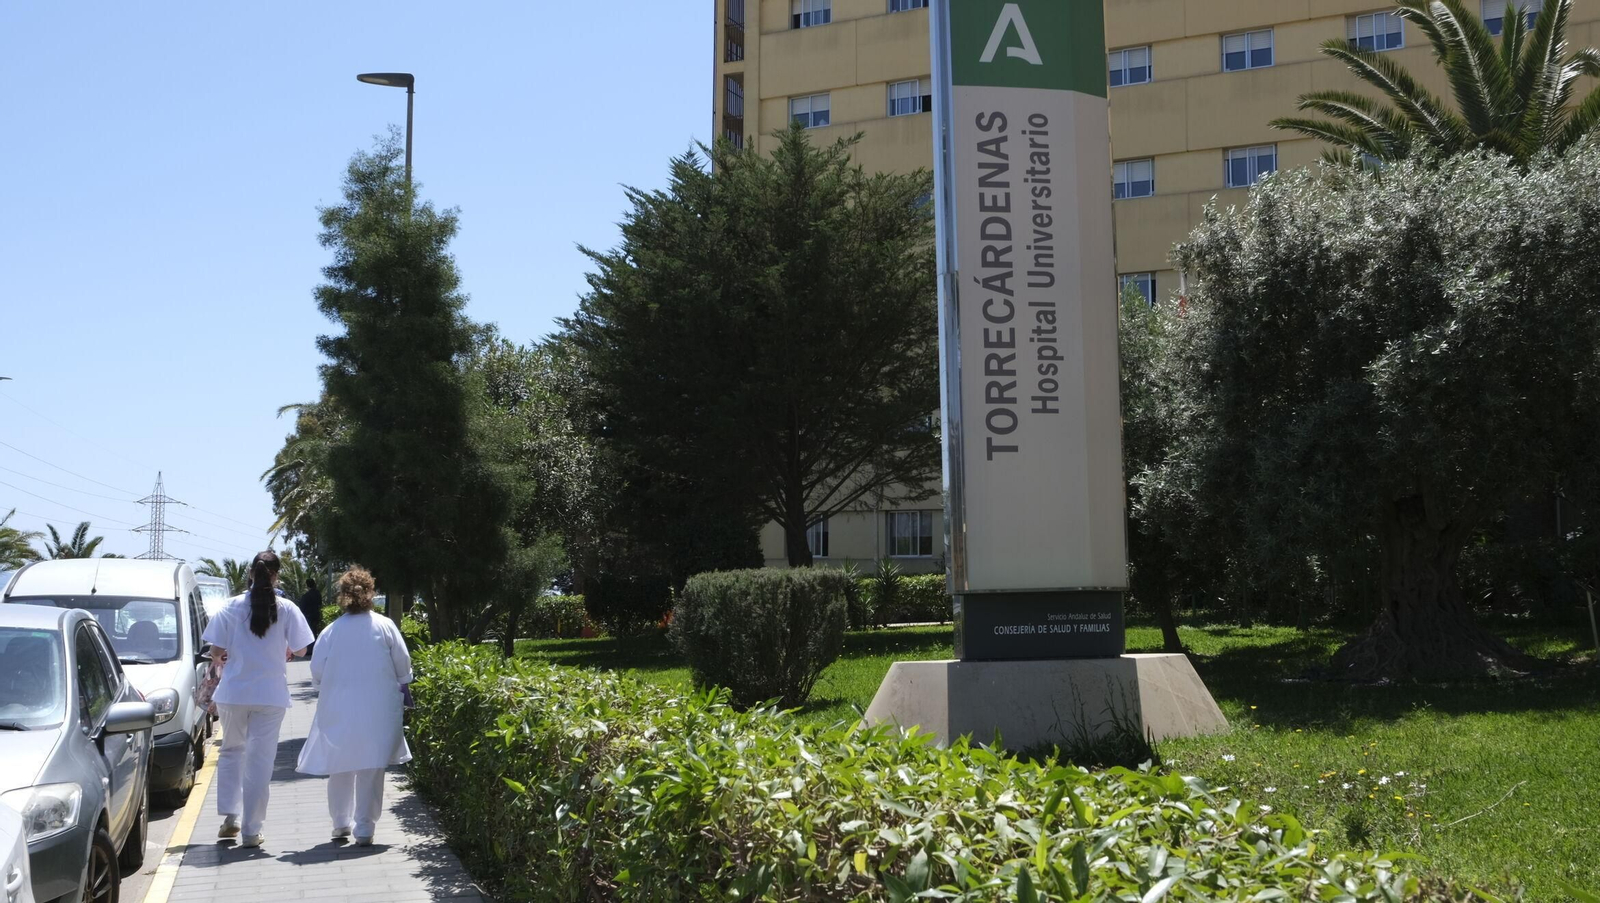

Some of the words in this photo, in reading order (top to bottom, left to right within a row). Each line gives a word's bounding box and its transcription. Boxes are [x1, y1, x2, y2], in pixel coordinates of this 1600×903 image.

[1021, 113, 1056, 288] Universitario
[973, 111, 1019, 461] TORRECÁRDENAS
[1028, 302, 1065, 414] Hospital
[993, 623, 1036, 635] CONSEJERÍA
[1037, 624, 1048, 634] DE
[1049, 623, 1071, 633] SALUD
[1073, 623, 1078, 632] Y
[1079, 623, 1111, 633] FAMILIAS
[1047, 613, 1067, 621] Servicio
[1068, 612, 1089, 620] Andaluz
[1089, 612, 1097, 620] de
[1097, 612, 1112, 620] Salud
